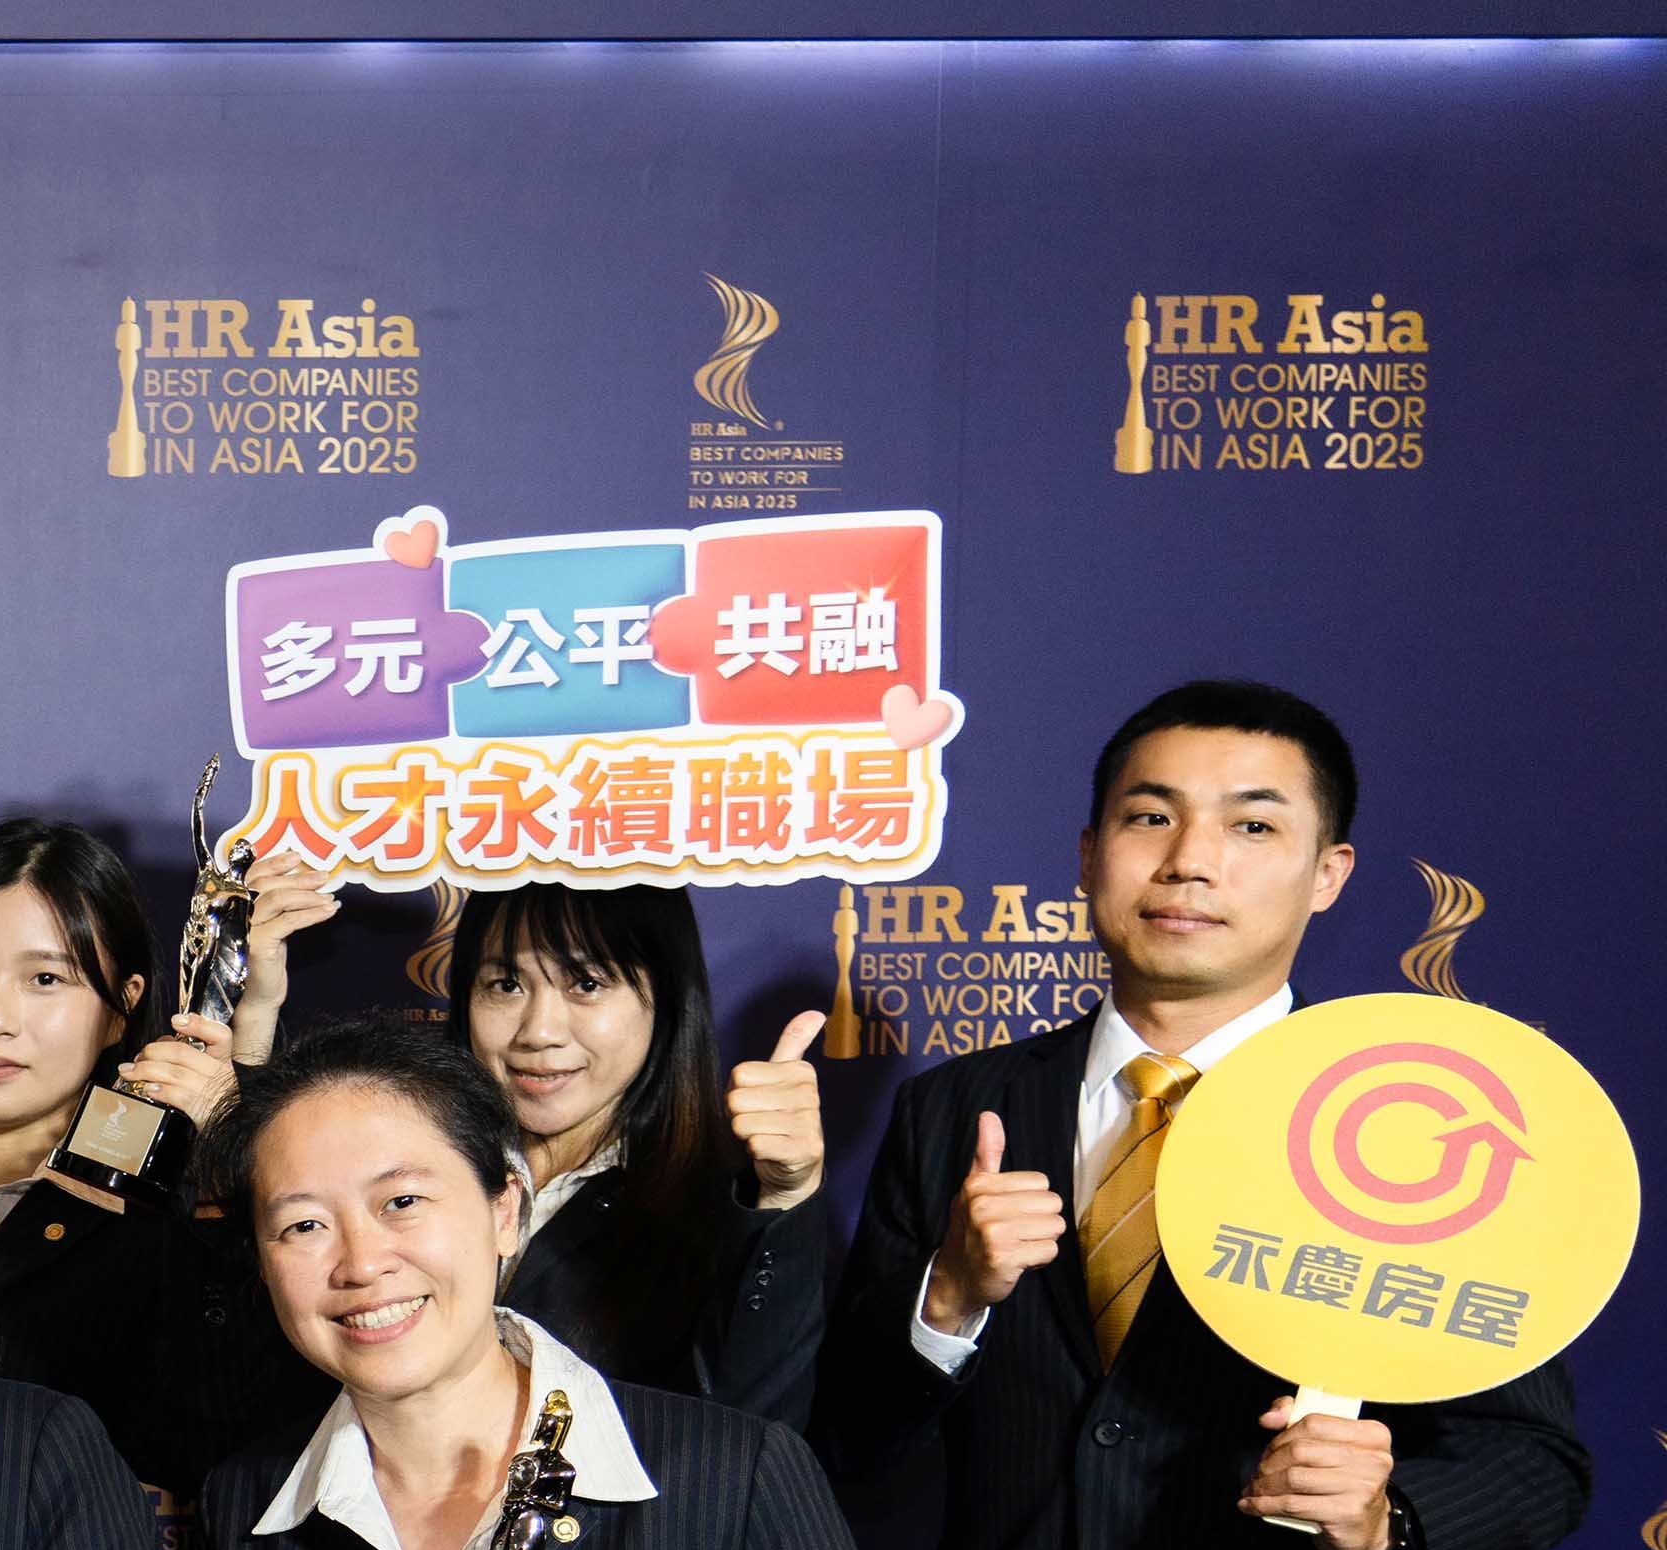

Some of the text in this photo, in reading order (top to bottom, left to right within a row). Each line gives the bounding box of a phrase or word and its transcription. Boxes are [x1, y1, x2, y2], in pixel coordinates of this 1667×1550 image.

[144, 298, 420, 358] HR Asia
[1153, 293, 1429, 354] HR Asia
[143, 368, 419, 397] BEST COMPANIES
[1151, 363, 1427, 393] BEST COMPANIES
[145, 400, 419, 433] TO WORK FOR
[716, 422, 747, 436] Asia
[1152, 396, 1427, 430] TO WORK FOR
[153, 437, 417, 474] IN ASIA 2025
[689, 447, 844, 461] BEST COMPANIES
[1160, 432, 1424, 470] IN ASIA 2025
[690, 471, 809, 485] TO WORK FOR
[688, 494, 797, 509] IN ASIA 2025
[260, 586, 899, 701] 多元 公平 共融
[251, 748, 914, 862] 人才永續職場
[861, 885, 1095, 943] HR Asi
[859, 952, 1112, 980] BEST COMPANIE
[860, 983, 1112, 1017] TO WORK FO
[869, 1019, 1012, 1056] IN ASIA
[1203, 1223, 1531, 1349] 永慶房屋
